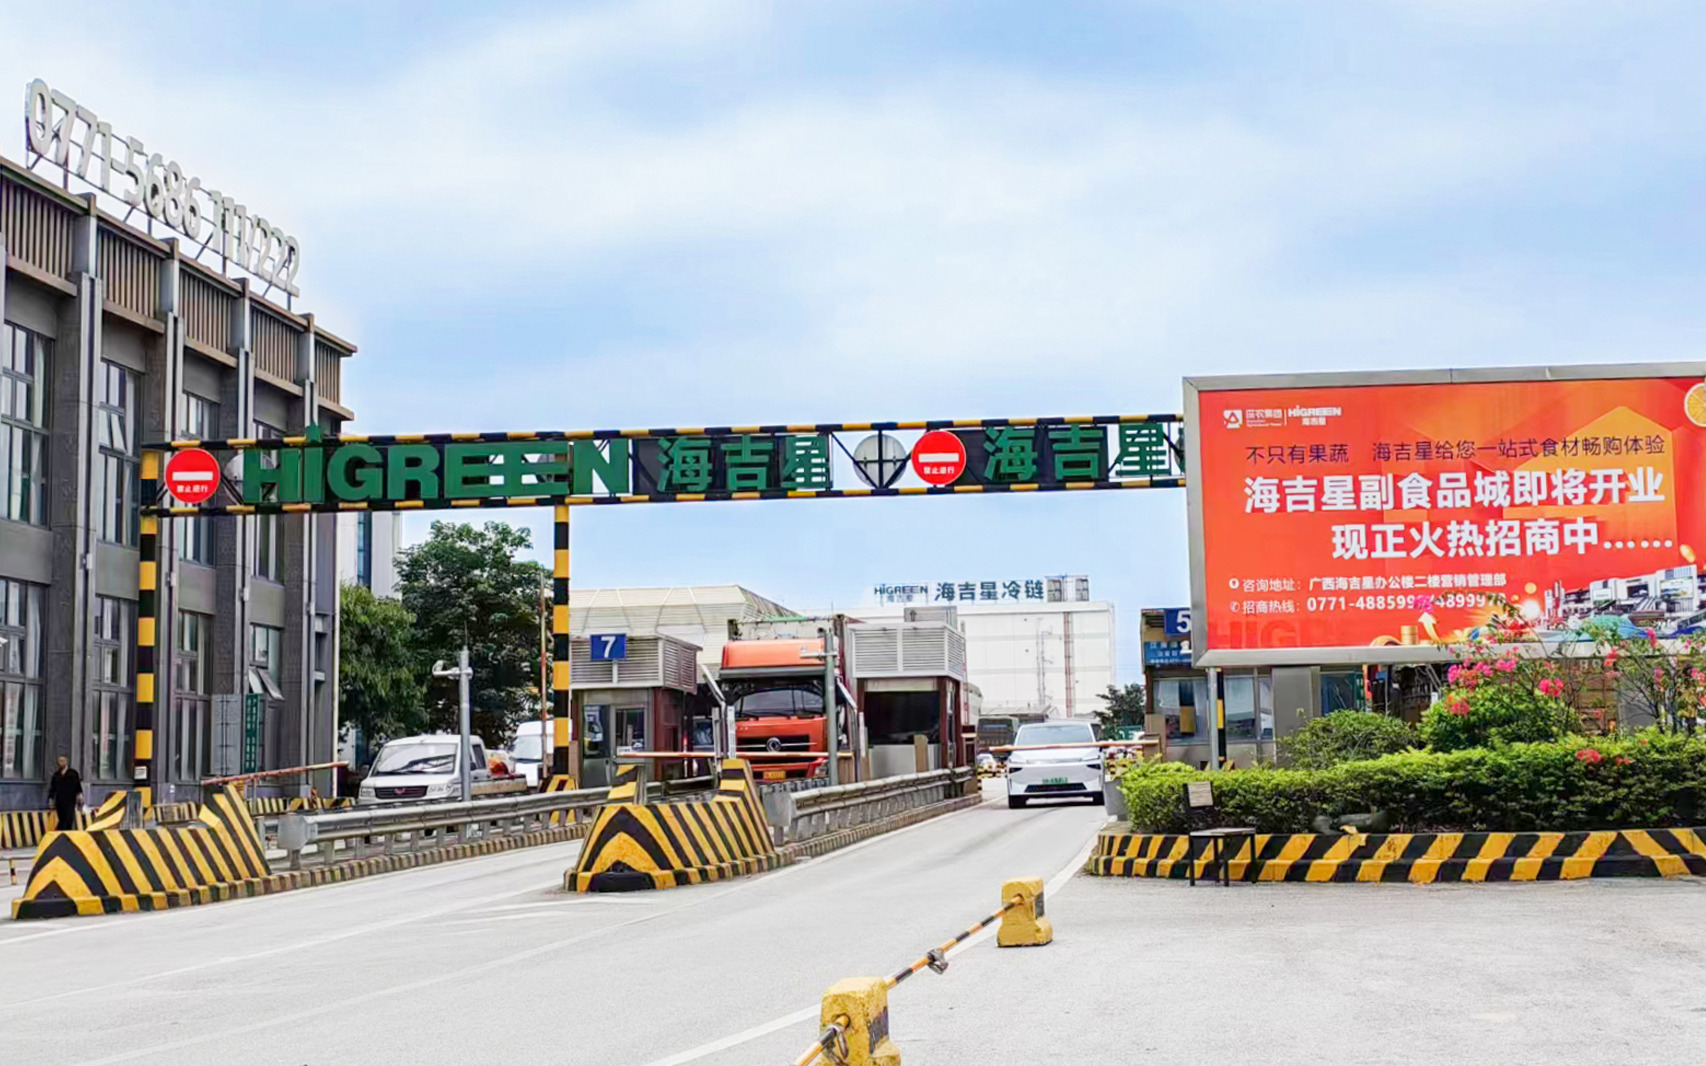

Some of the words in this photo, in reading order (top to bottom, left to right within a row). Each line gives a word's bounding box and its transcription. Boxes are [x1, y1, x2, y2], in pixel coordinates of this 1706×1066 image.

[656, 434, 834, 493] 海吉星
[983, 422, 1172, 482] 海吉星
[1246, 443, 1350, 466] 不只有果蔬
[1372, 434, 1666, 462] 海吉星给您一站式食材畅购体验
[1244, 466, 1665, 514] 海吉星副食品城即将开业
[935, 581, 1044, 601] 海吉星冷链
[1177, 610, 1192, 633] 5
[601, 636, 616, 658] 7
